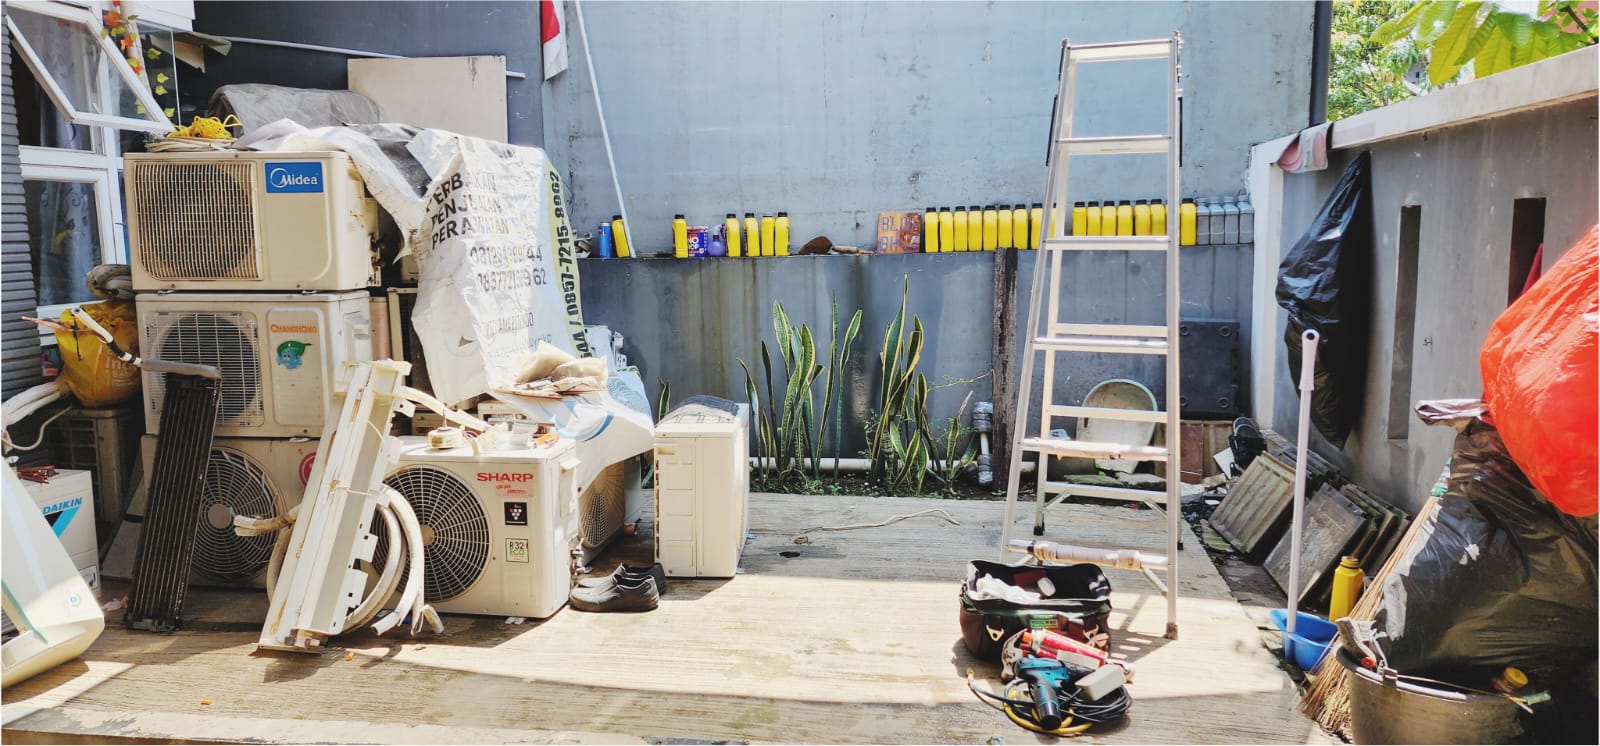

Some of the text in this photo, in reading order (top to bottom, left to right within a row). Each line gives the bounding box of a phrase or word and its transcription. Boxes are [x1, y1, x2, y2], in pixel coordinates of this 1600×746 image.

[274, 171, 318, 187] Midea
[476, 472, 534, 483] SHARP
[42, 497, 83, 515] DAIKIN
